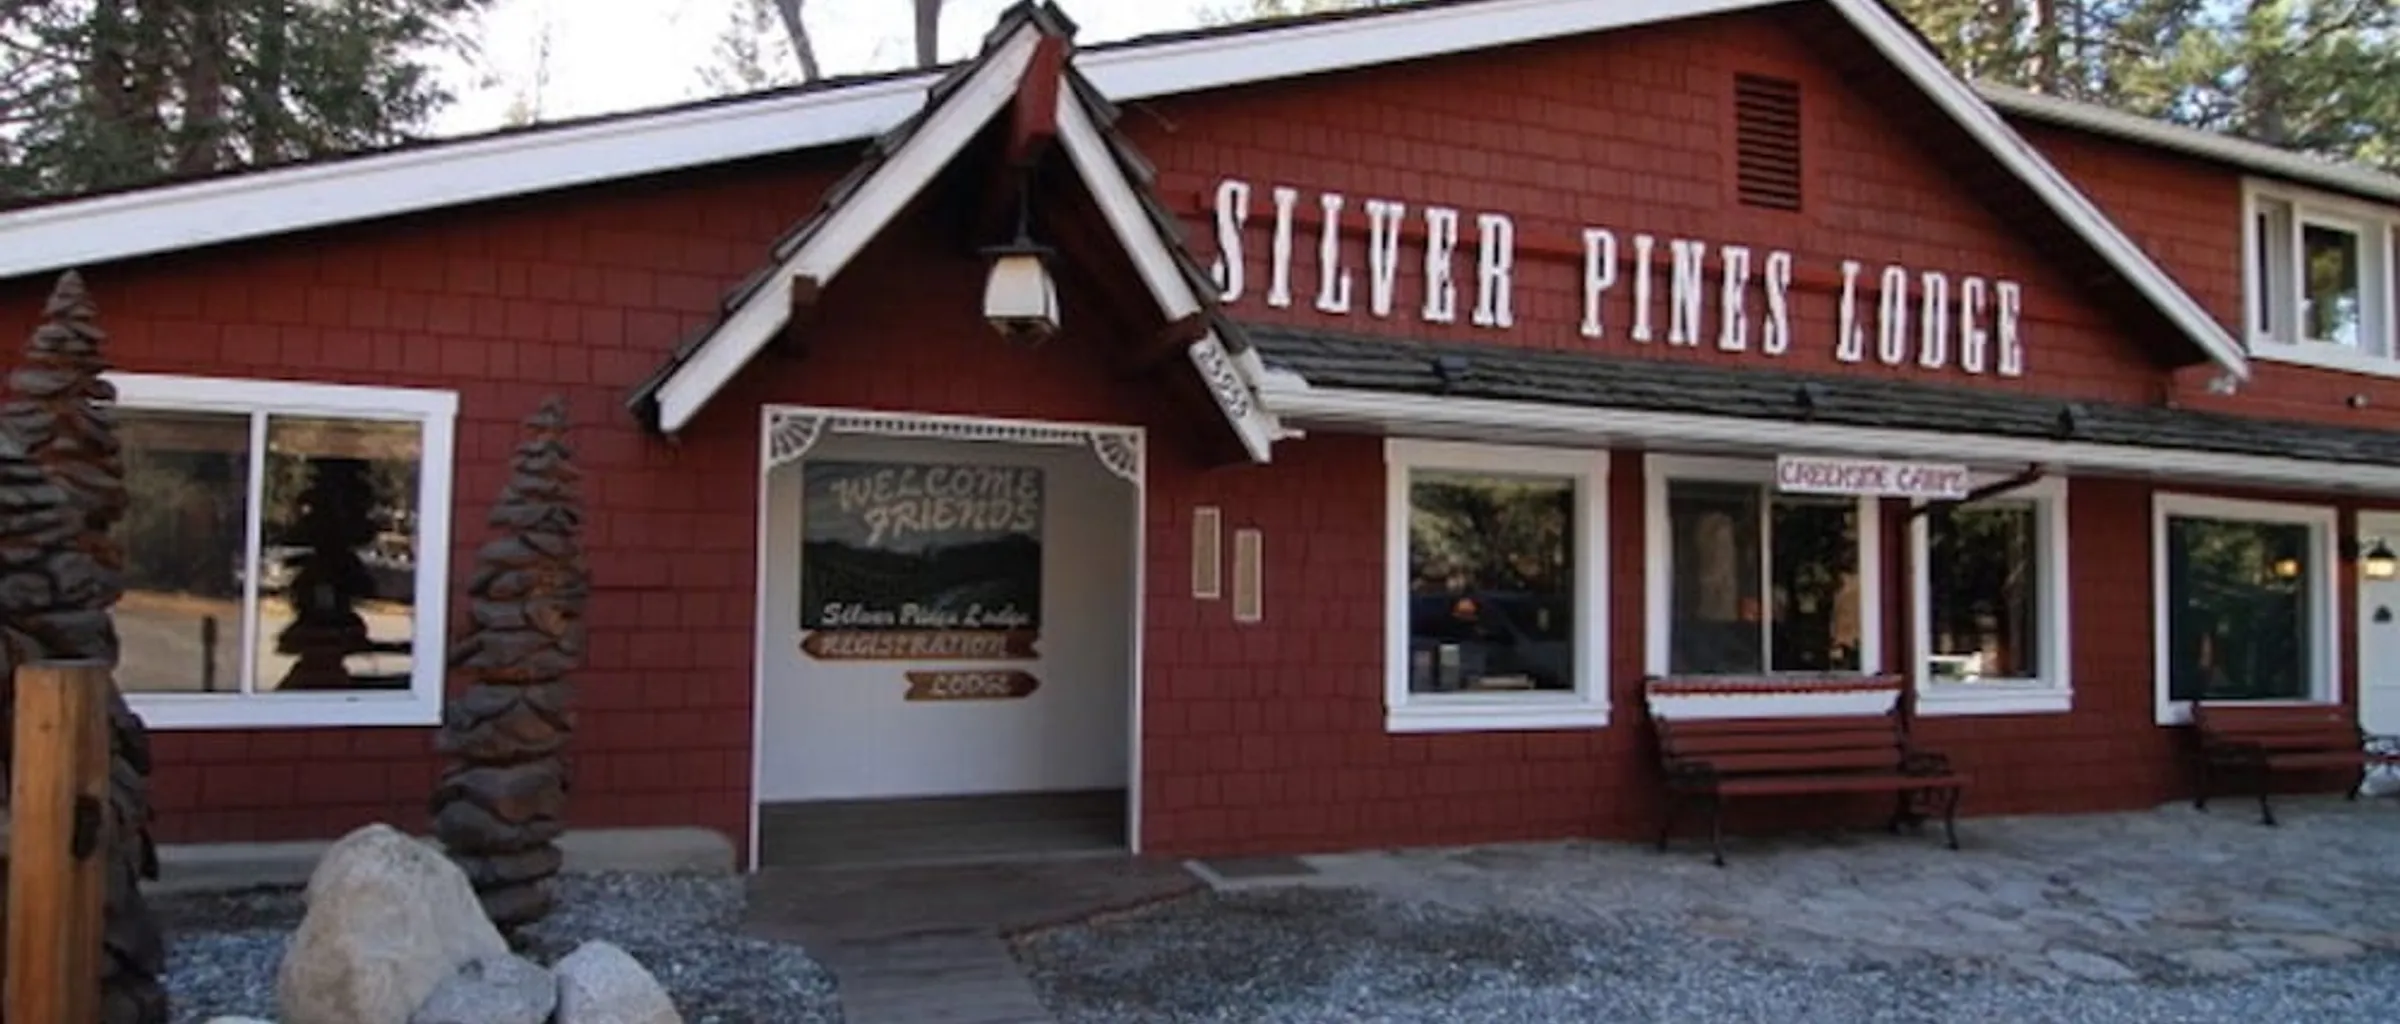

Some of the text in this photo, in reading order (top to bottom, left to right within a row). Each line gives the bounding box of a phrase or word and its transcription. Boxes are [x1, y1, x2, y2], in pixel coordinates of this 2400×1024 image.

[1211, 179, 2021, 376] SILVER PINES LODGE
[829, 466, 1039, 511] WELCOME
[863, 498, 1038, 547] FRIENDS
[821, 602, 896, 625] Silver
[820, 631, 1007, 656] REGISTRATION
[928, 674, 1011, 696] LODGE
